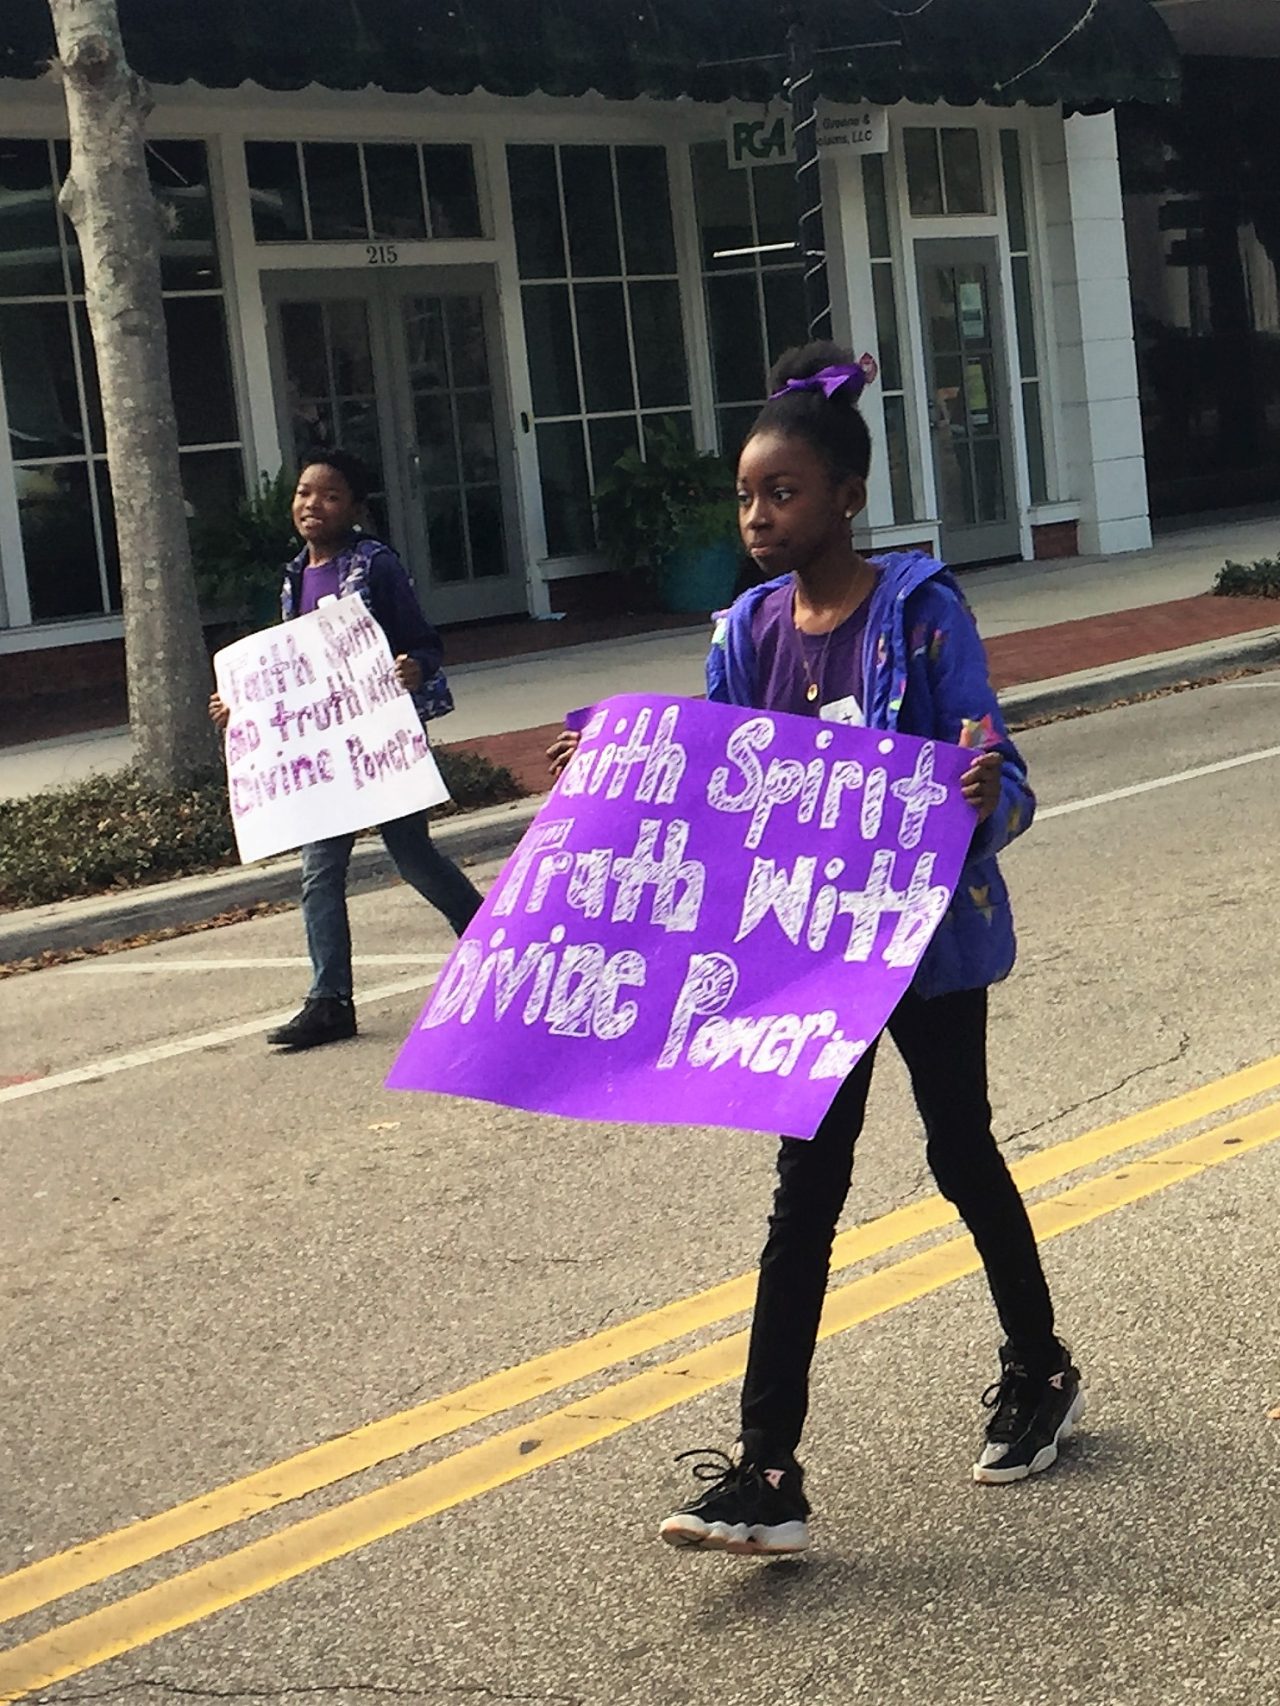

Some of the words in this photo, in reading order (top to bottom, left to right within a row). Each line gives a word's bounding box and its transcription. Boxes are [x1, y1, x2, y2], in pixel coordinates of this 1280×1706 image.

[852, 130, 872, 143] LLC
[366, 245, 397, 264] 215
[707, 717, 948, 850] Spirit
[733, 849, 950, 970] With
[656, 952, 838, 1077] Power
